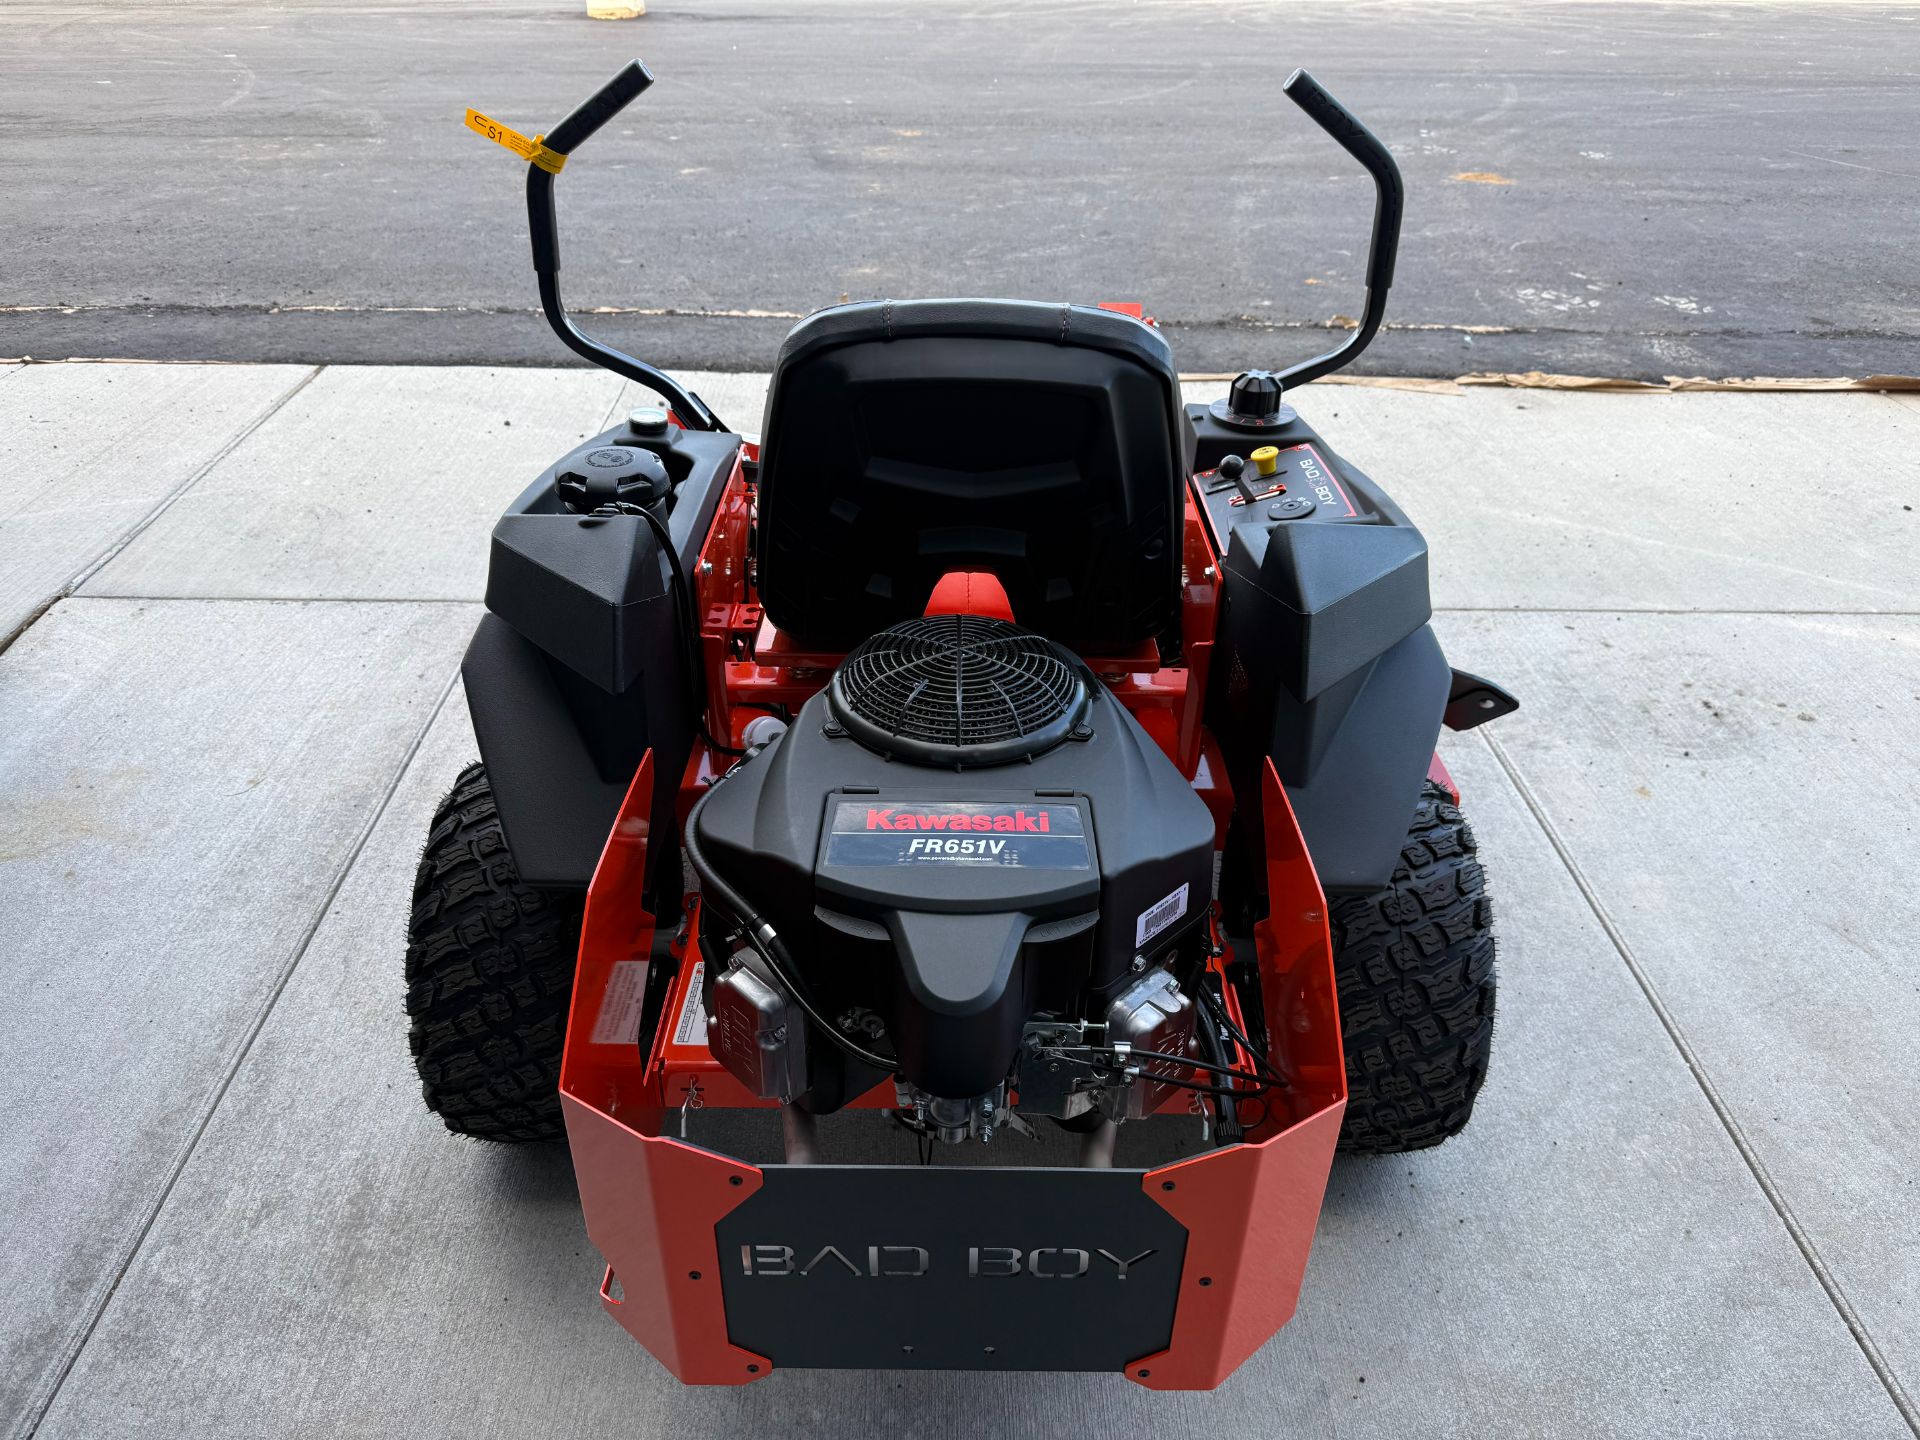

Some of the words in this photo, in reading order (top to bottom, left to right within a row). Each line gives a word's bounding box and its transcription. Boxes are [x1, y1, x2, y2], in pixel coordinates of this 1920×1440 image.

[1299, 458, 1320, 479] BAD
[1314, 485, 1338, 505] BOY
[866, 809, 1050, 833] Kawasaki
[909, 838, 1007, 855] FR651V
[740, 1244, 930, 1277] BAD
[968, 1246, 1160, 1280] BOY
